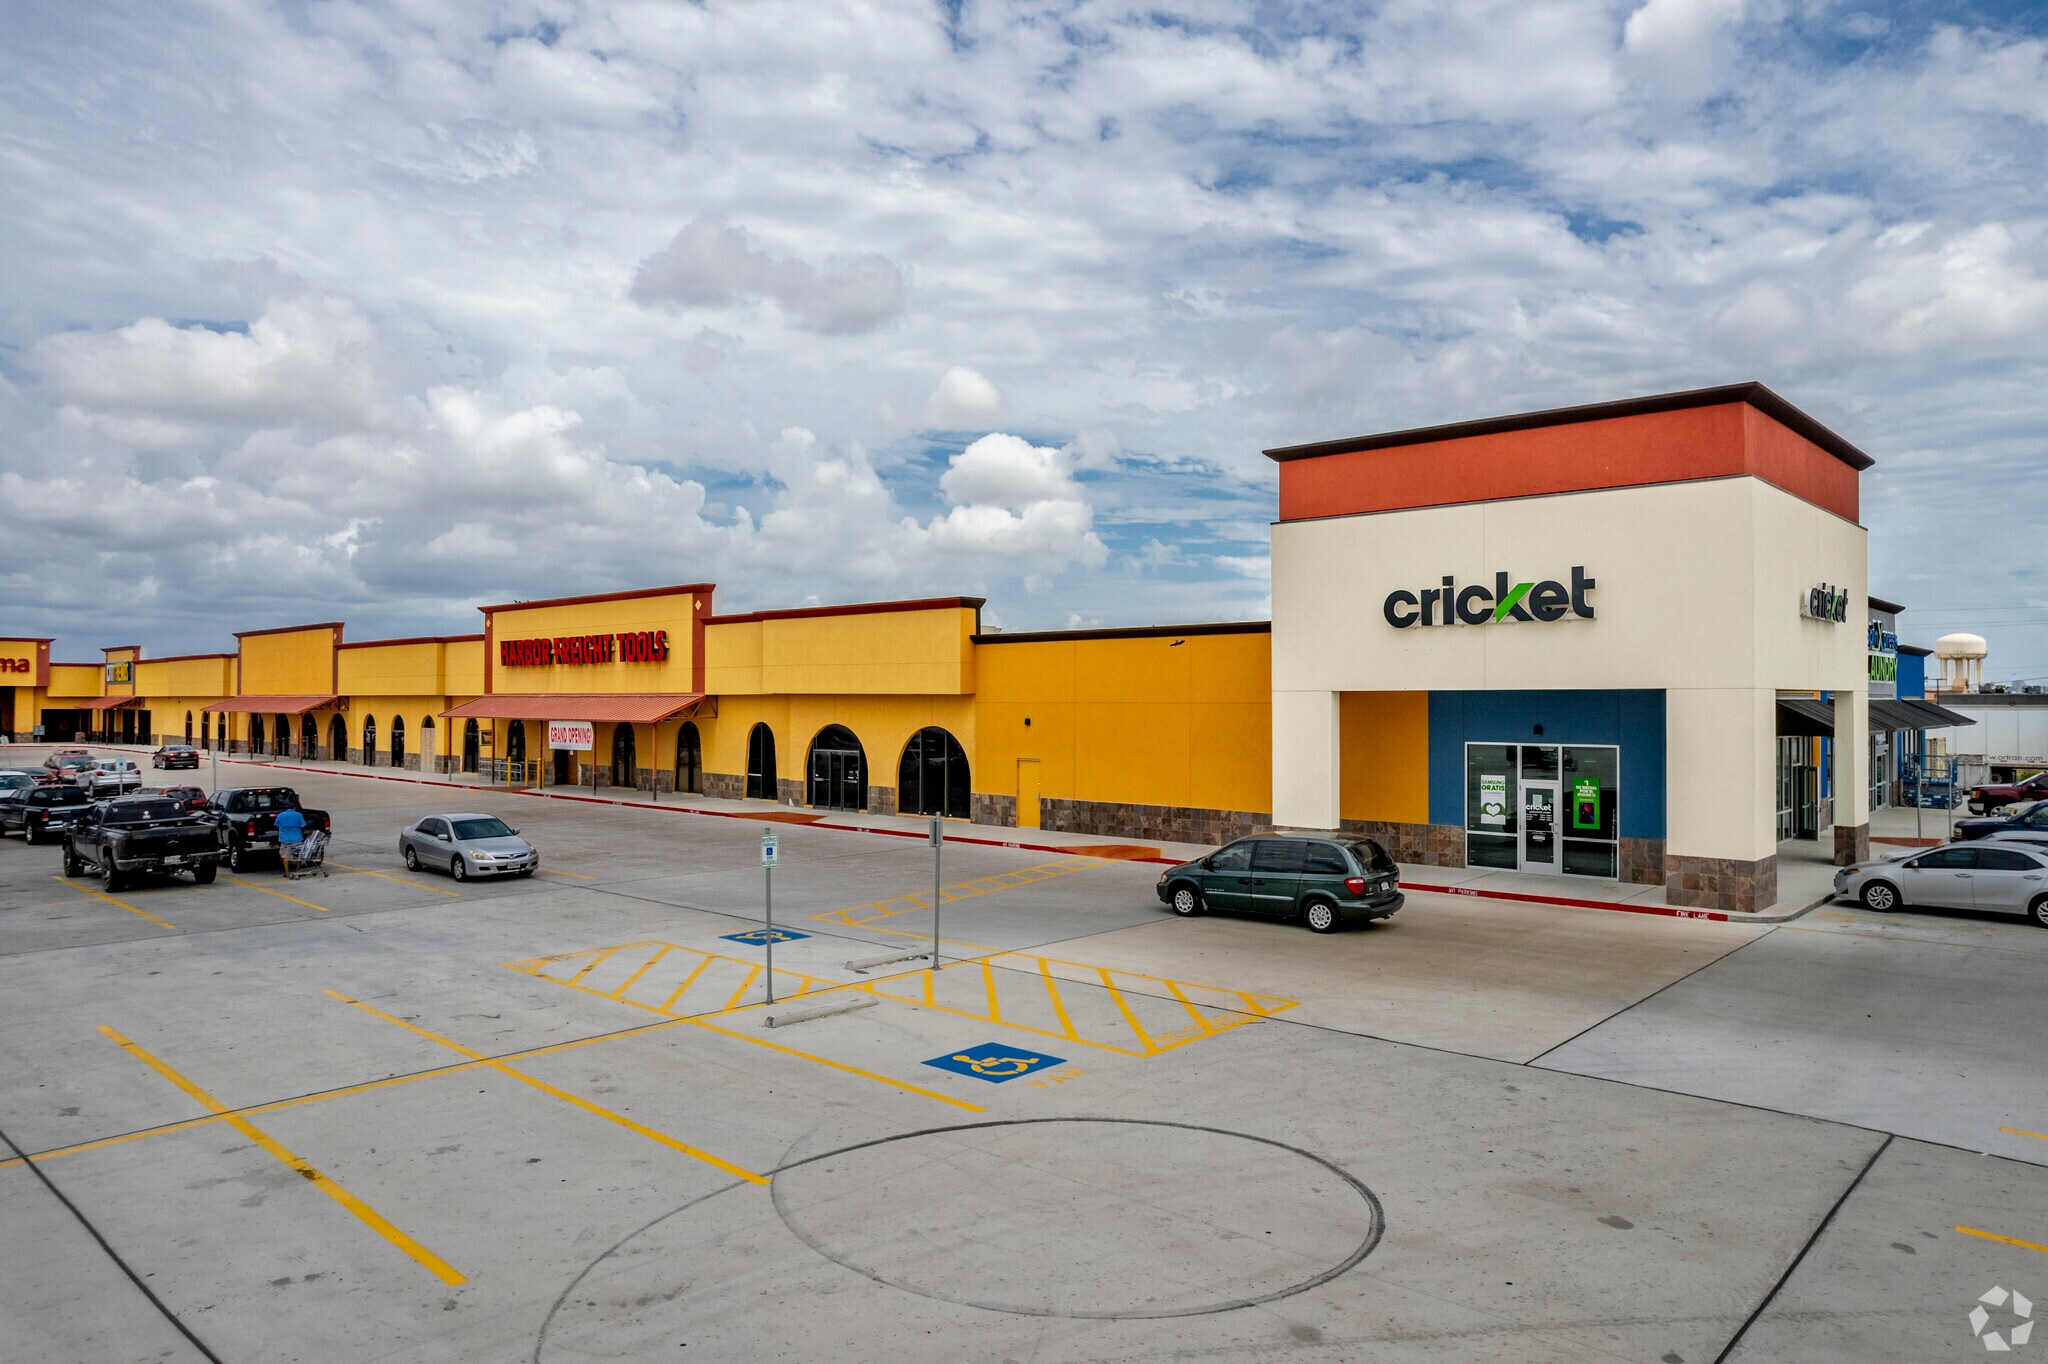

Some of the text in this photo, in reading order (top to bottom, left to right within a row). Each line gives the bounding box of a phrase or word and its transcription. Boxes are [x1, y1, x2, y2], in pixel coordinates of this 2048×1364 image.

[1383, 565, 1597, 630] cricket
[1808, 582, 1849, 623] cricket
[500, 630, 668, 667] HARBOR FREIGHT TOOLS
[551, 727, 567, 743] GRAND
[1693, 912, 1710, 920] LANE
